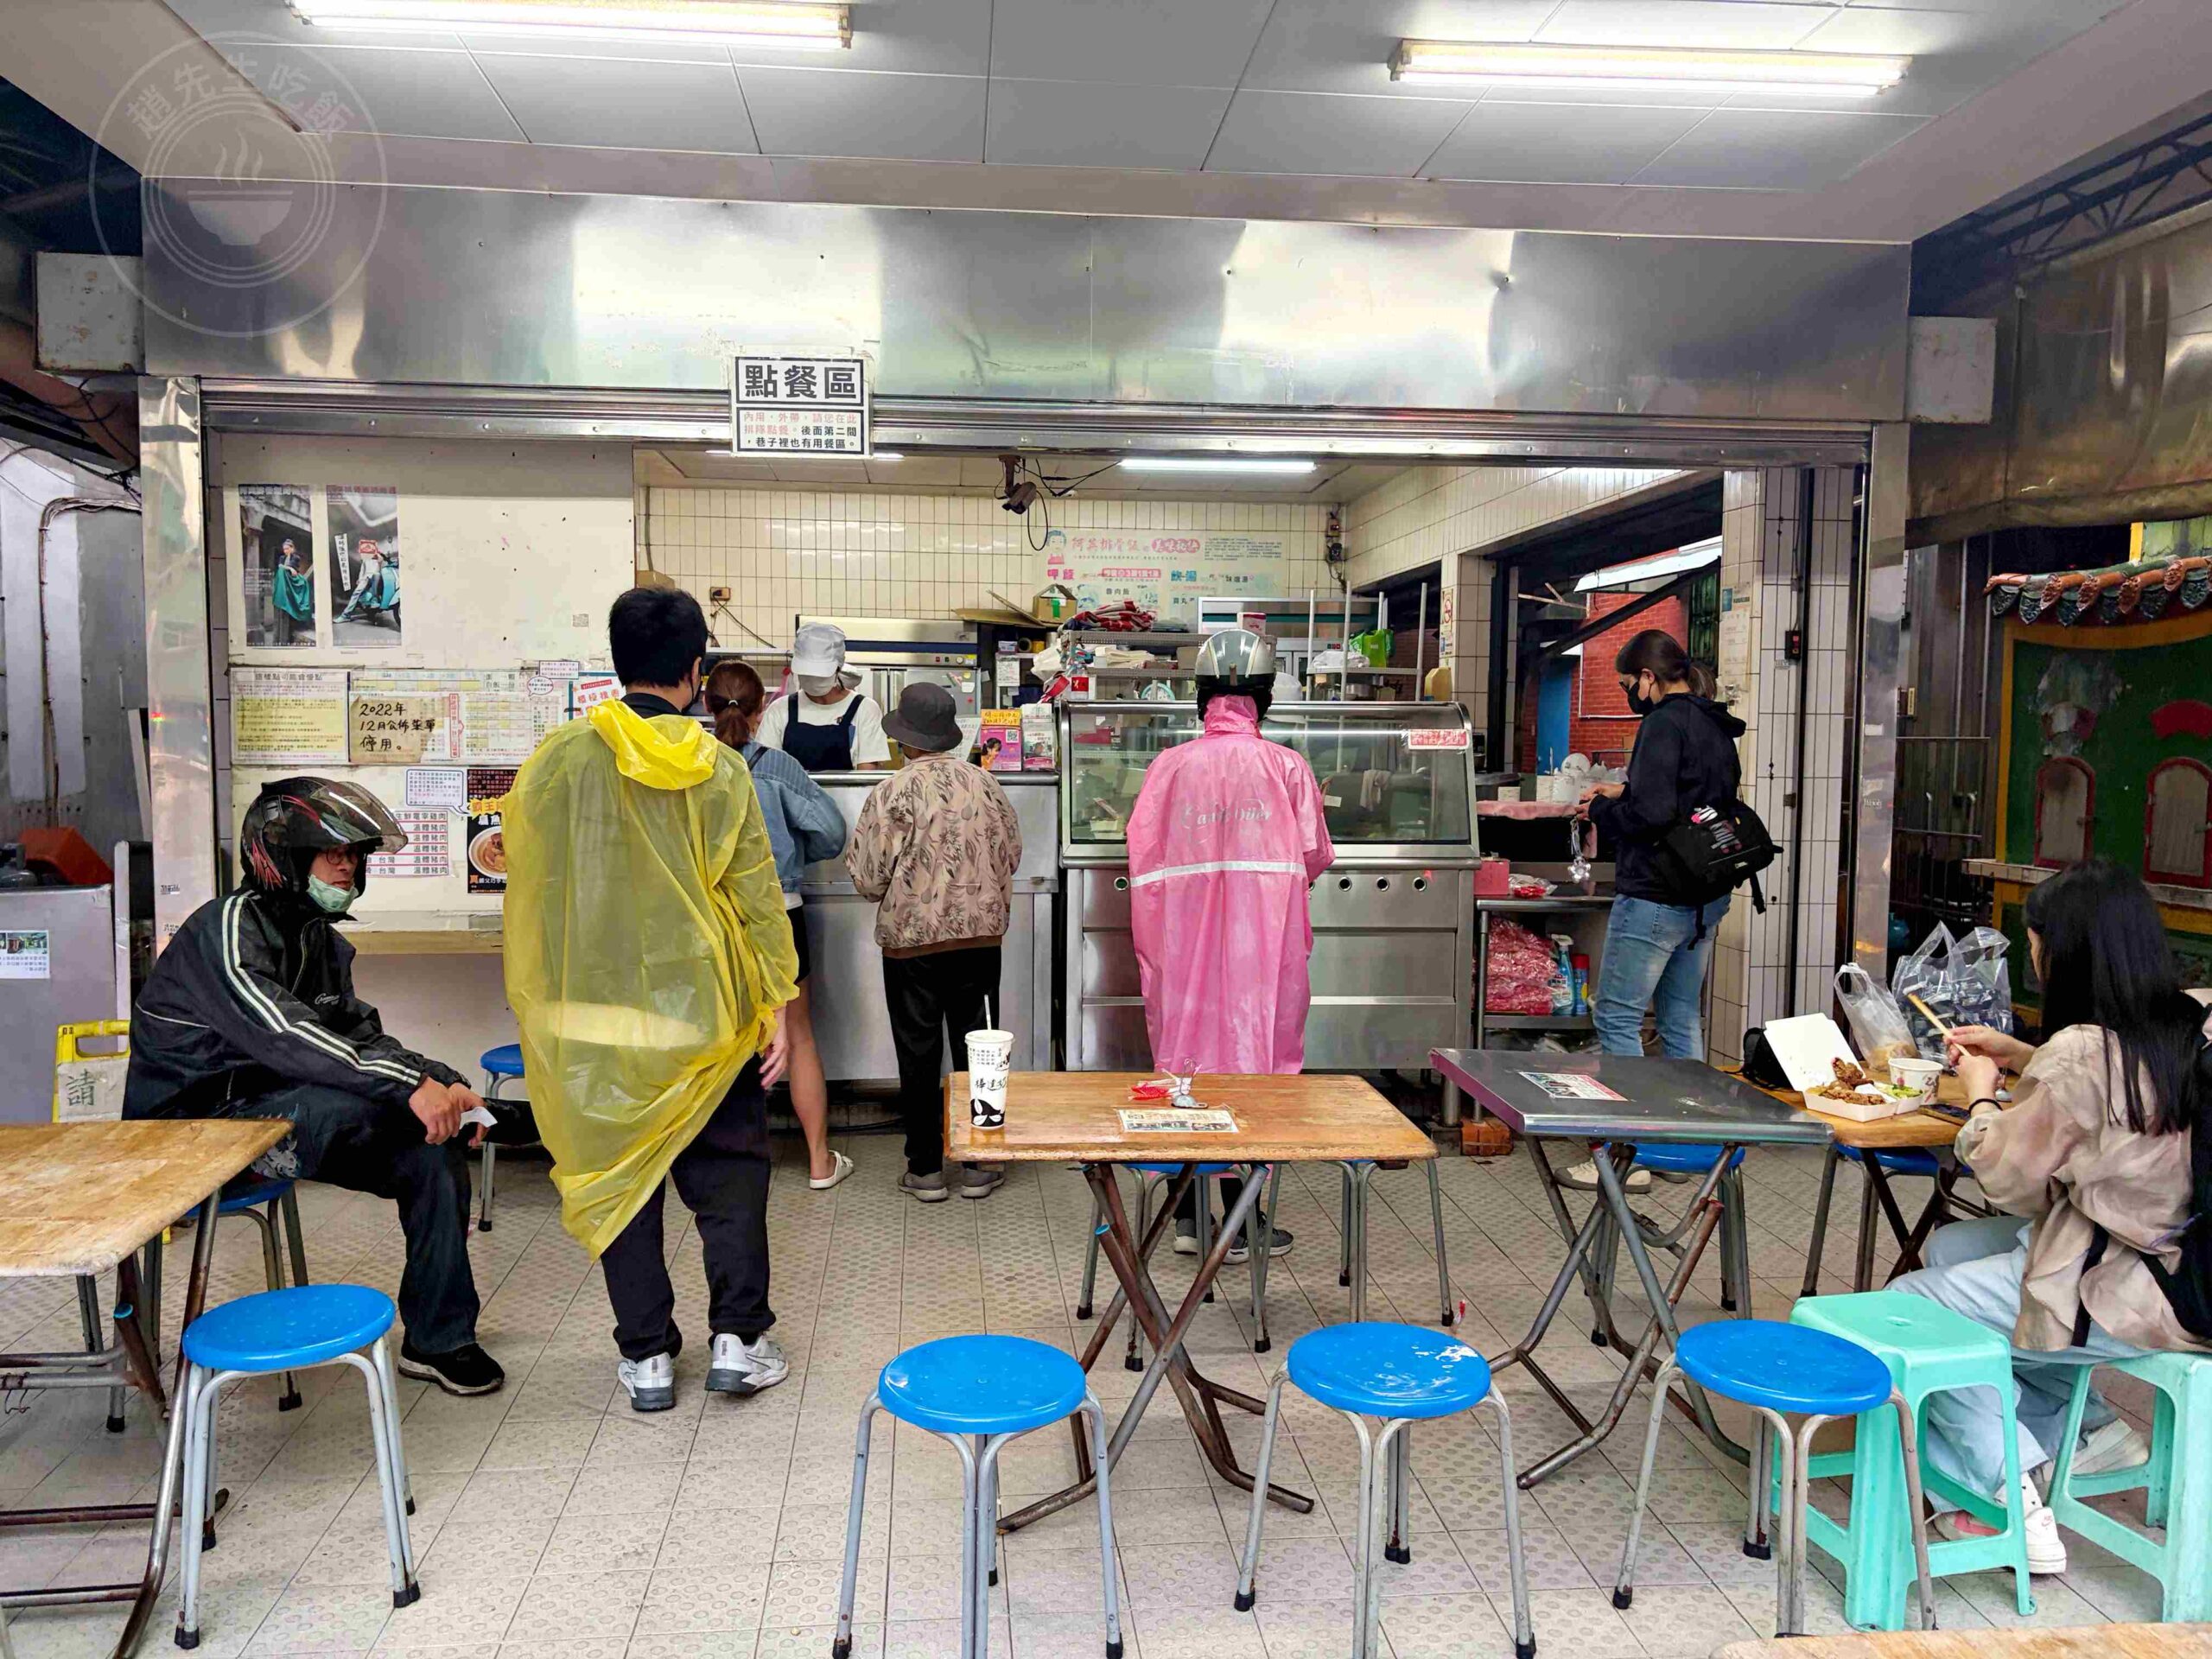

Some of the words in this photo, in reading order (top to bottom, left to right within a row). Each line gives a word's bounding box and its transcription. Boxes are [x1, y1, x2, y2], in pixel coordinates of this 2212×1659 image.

[745, 365, 857, 399] 點餐區
[359, 702, 407, 717] 2022年
[66, 1068, 95, 1106] 請
